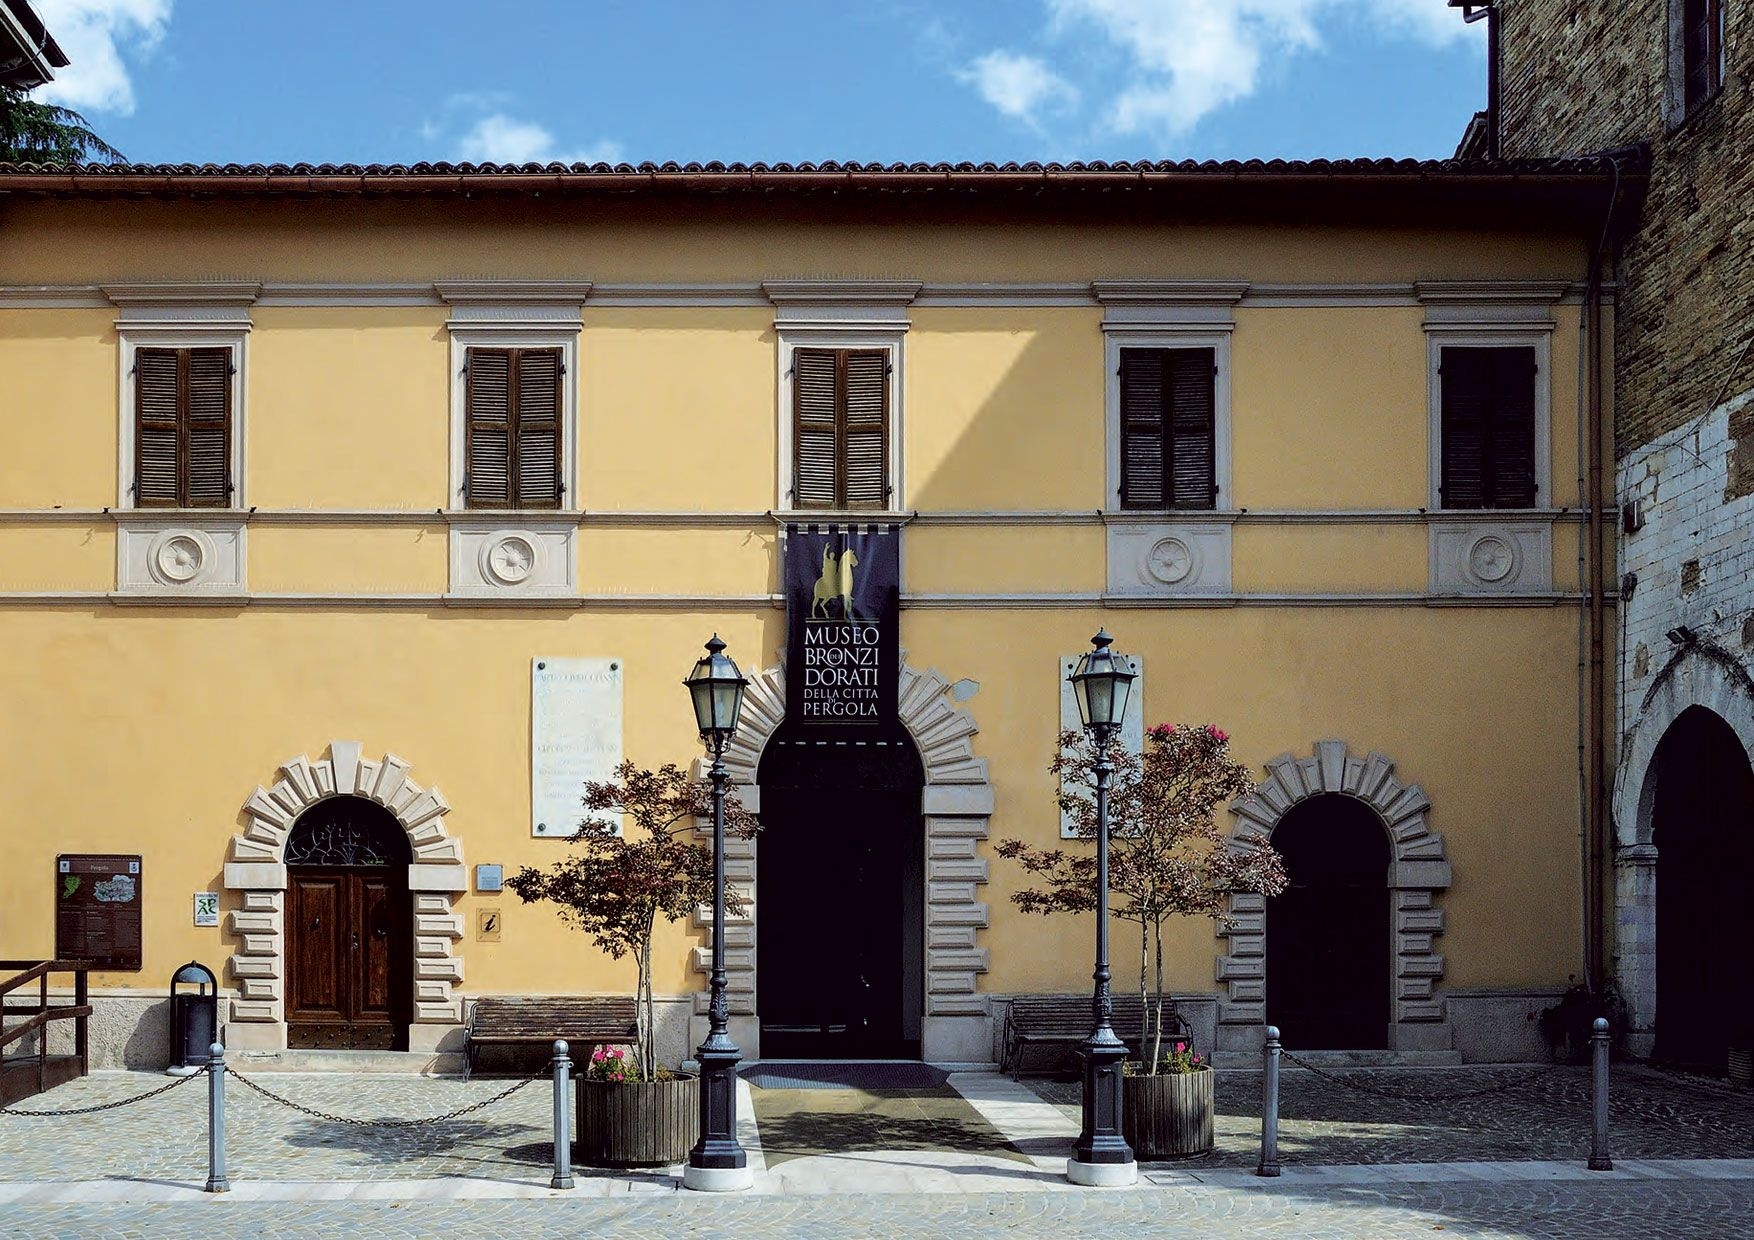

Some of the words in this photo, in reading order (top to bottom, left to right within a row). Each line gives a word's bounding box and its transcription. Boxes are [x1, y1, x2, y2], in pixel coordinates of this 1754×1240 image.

[804, 626, 879, 645] MUSEO
[805, 647, 879, 668] BRONZI
[805, 668, 878, 686] DORATI
[804, 688, 840, 699] DELLA
[803, 702, 878, 716] PERGOLA
